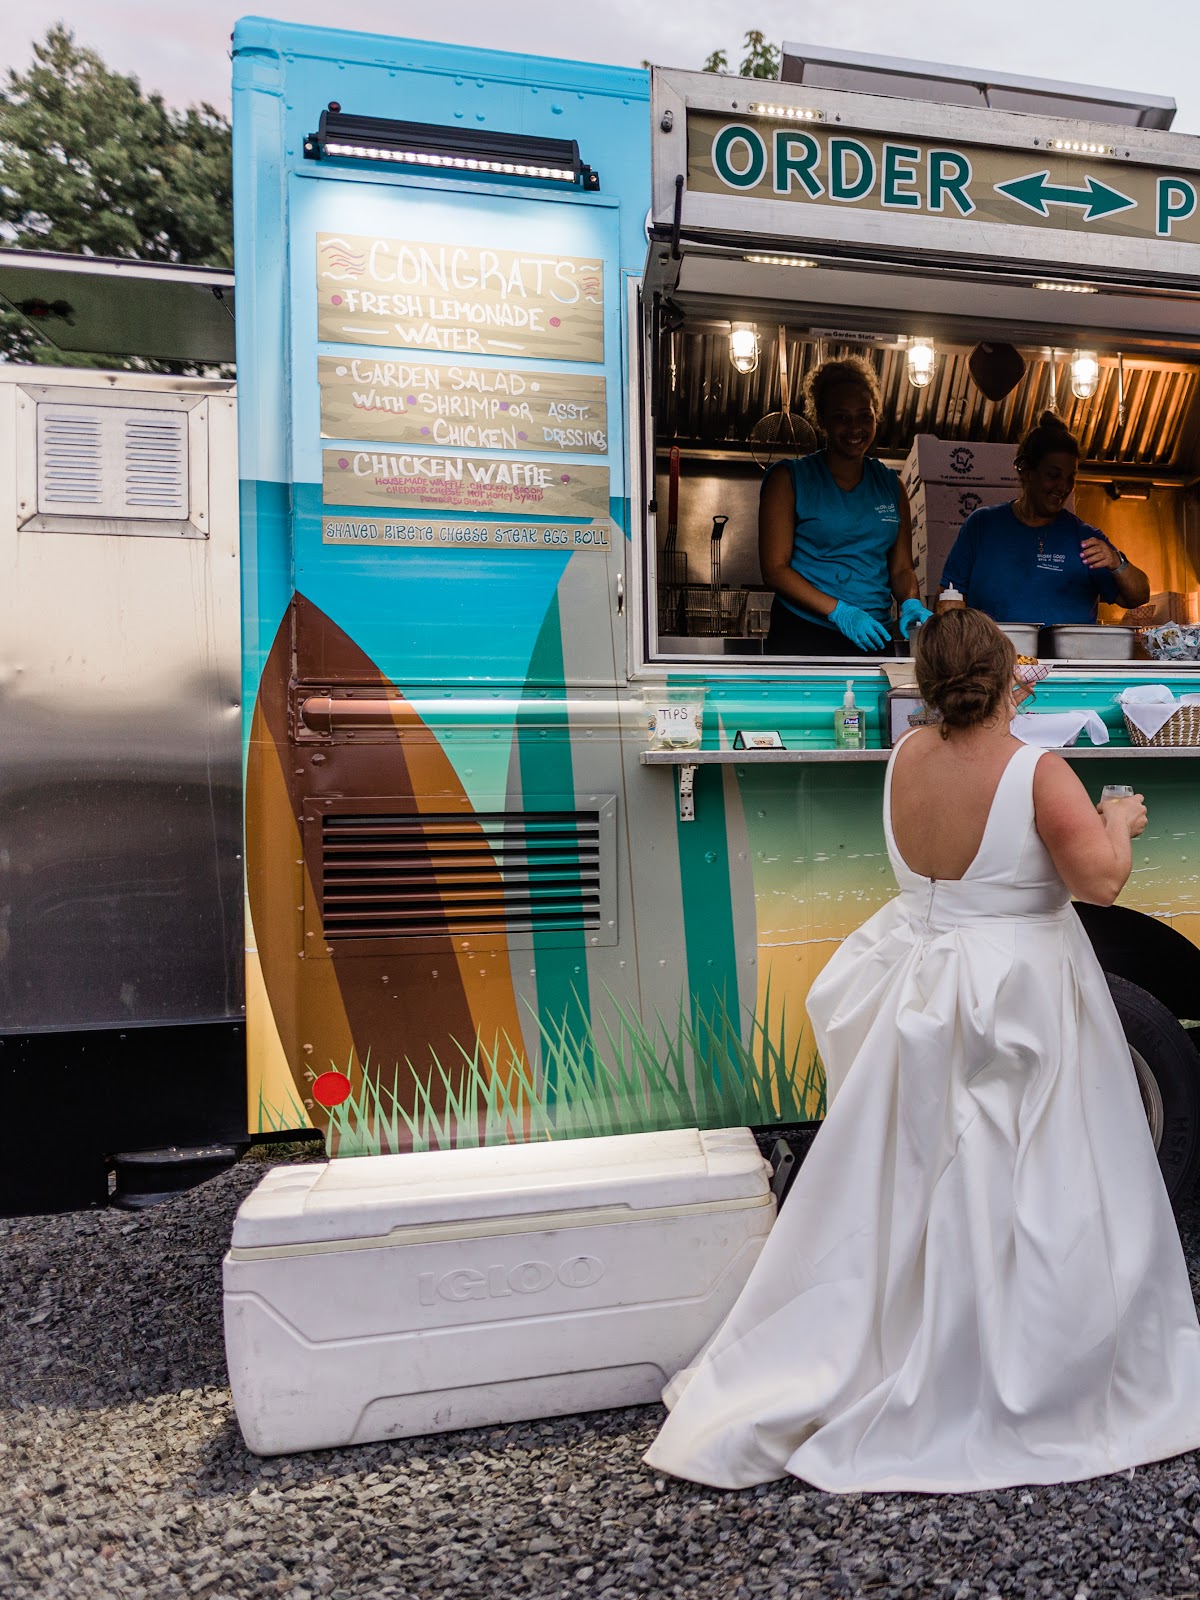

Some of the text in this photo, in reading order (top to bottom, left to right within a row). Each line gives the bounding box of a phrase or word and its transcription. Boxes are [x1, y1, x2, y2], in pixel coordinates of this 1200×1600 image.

[711, 123, 977, 216] ORDER
[369, 240, 580, 304] CONGRATS
[341, 288, 545, 332] FRESH LEMONADE
[395, 323, 486, 352] WATER
[351, 360, 526, 394] GARDEN SALAD
[352, 389, 589, 423] WITH SHRIMP OR ASST.
[432, 418, 518, 449] CHICKEN
[353, 453, 555, 489] CHICKEN WAFFLE
[325, 522, 609, 545] SHAVED RIBEYE CHEESE STEAK EGG ROLL
[418, 1254, 607, 1307] IGLOO
